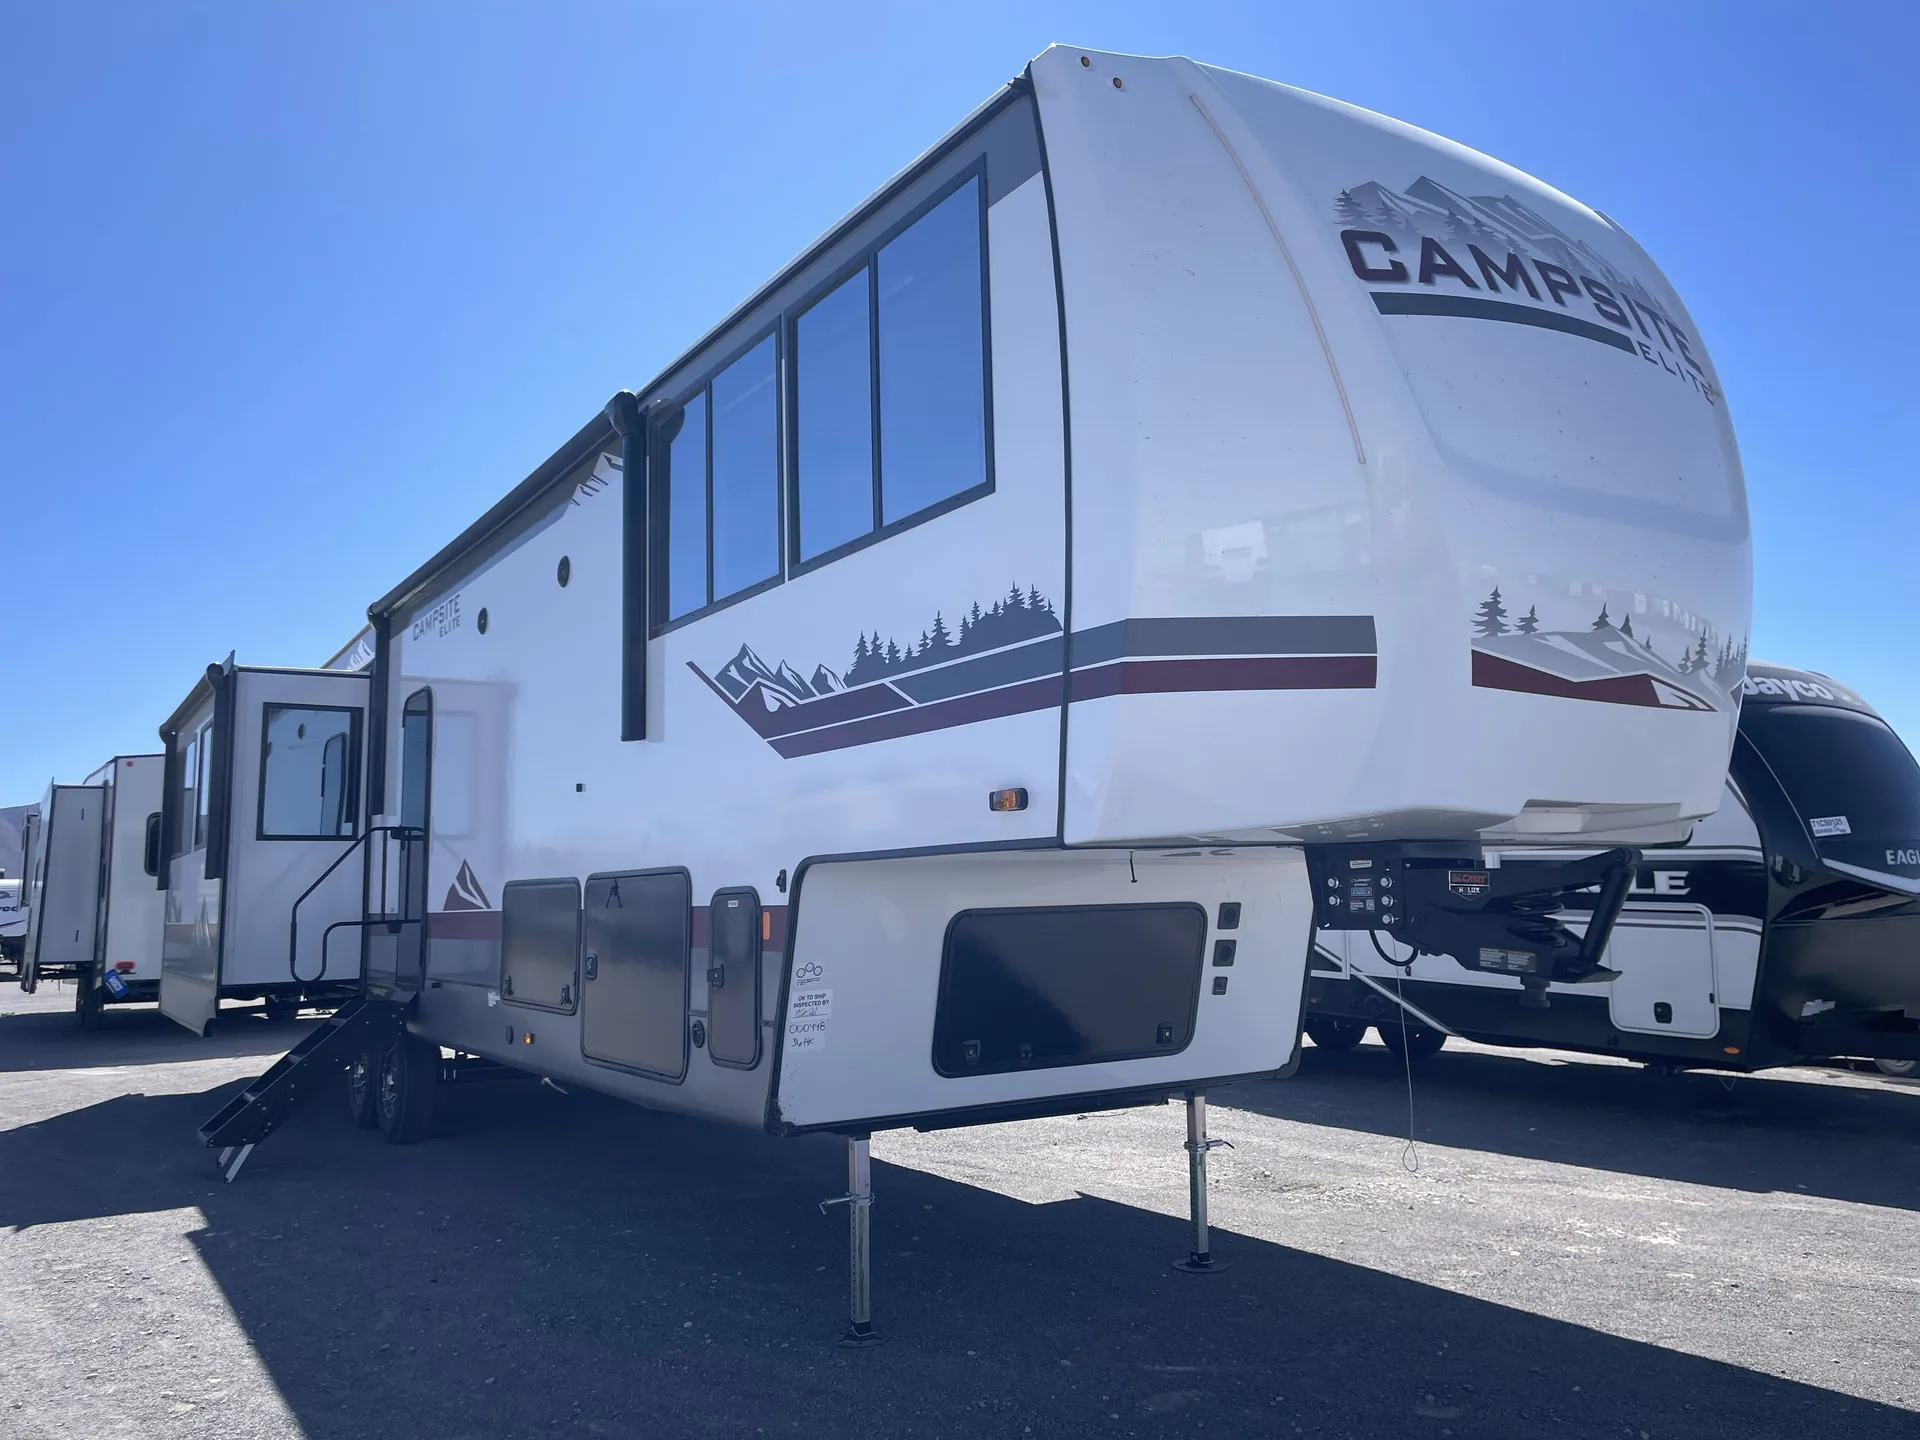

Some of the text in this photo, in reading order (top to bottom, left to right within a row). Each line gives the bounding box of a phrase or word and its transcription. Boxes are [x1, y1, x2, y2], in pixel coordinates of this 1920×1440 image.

[1340, 229, 1705, 377] CAMPSITE
[1637, 340, 1715, 406] ELITE
[413, 594, 461, 641] CAMPSITE
[439, 614, 461, 638] ELITE
[1629, 868, 1691, 895] LE
[793, 1000, 822, 1008] INSPECTED
